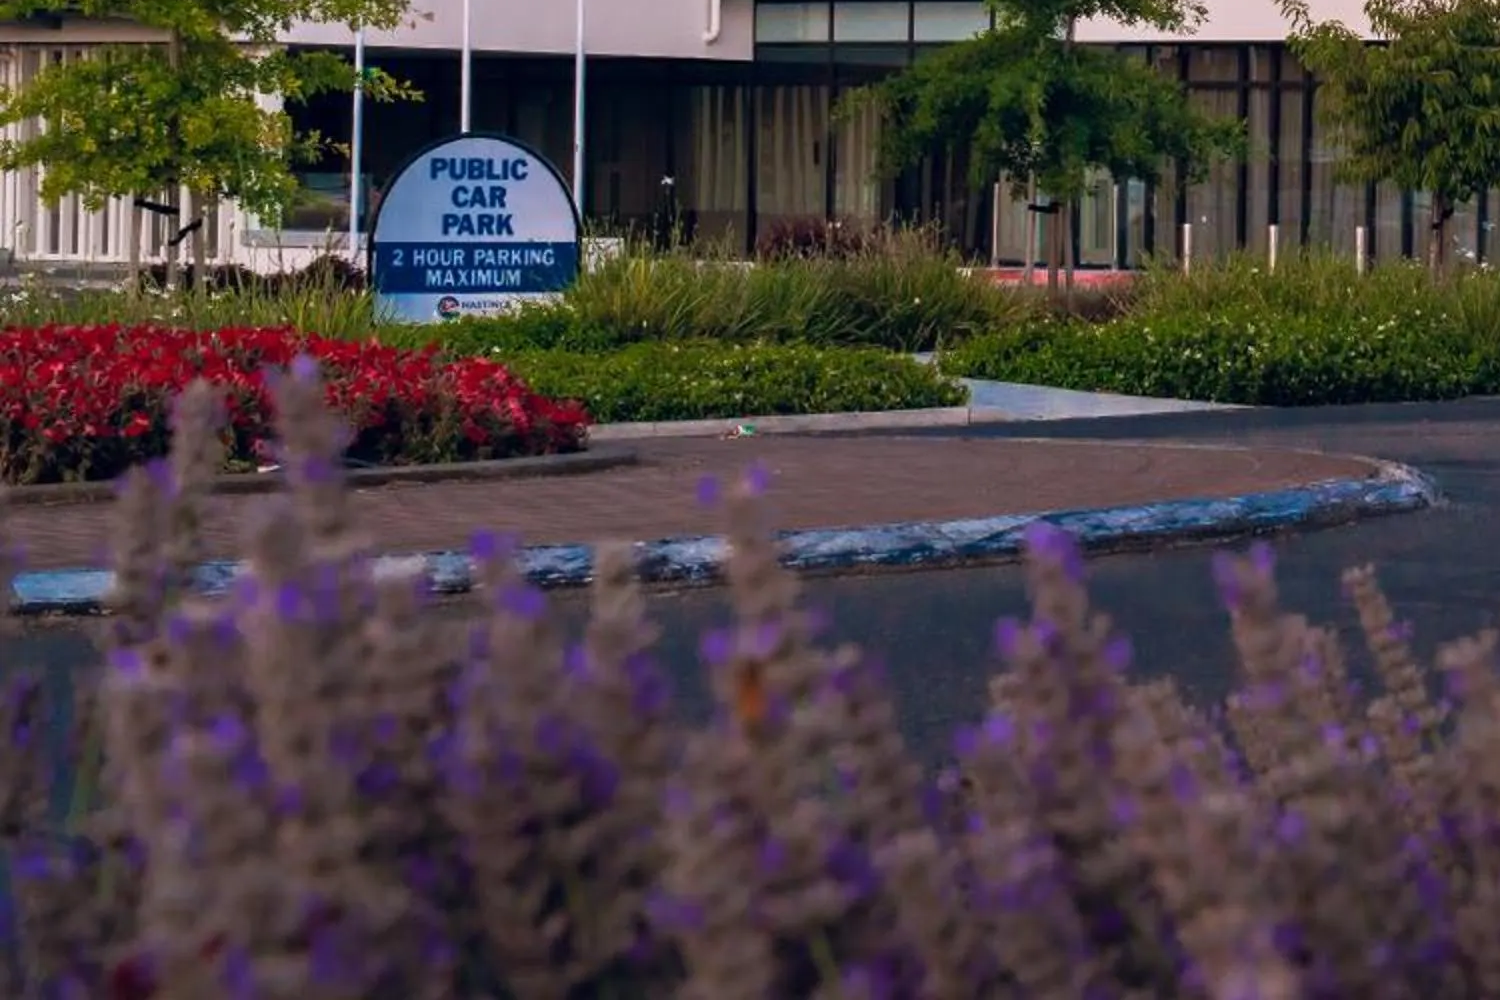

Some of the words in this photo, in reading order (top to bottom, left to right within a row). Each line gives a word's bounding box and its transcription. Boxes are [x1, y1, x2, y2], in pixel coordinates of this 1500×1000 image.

[430, 157, 528, 181] PUBLIC
[451, 185, 508, 209] CAR
[441, 213, 514, 236] PARK
[392, 249, 404, 266] 2
[412, 249, 465, 266] HOUR
[473, 248, 556, 267] PARKING
[425, 269, 522, 287] MAXIMUM
